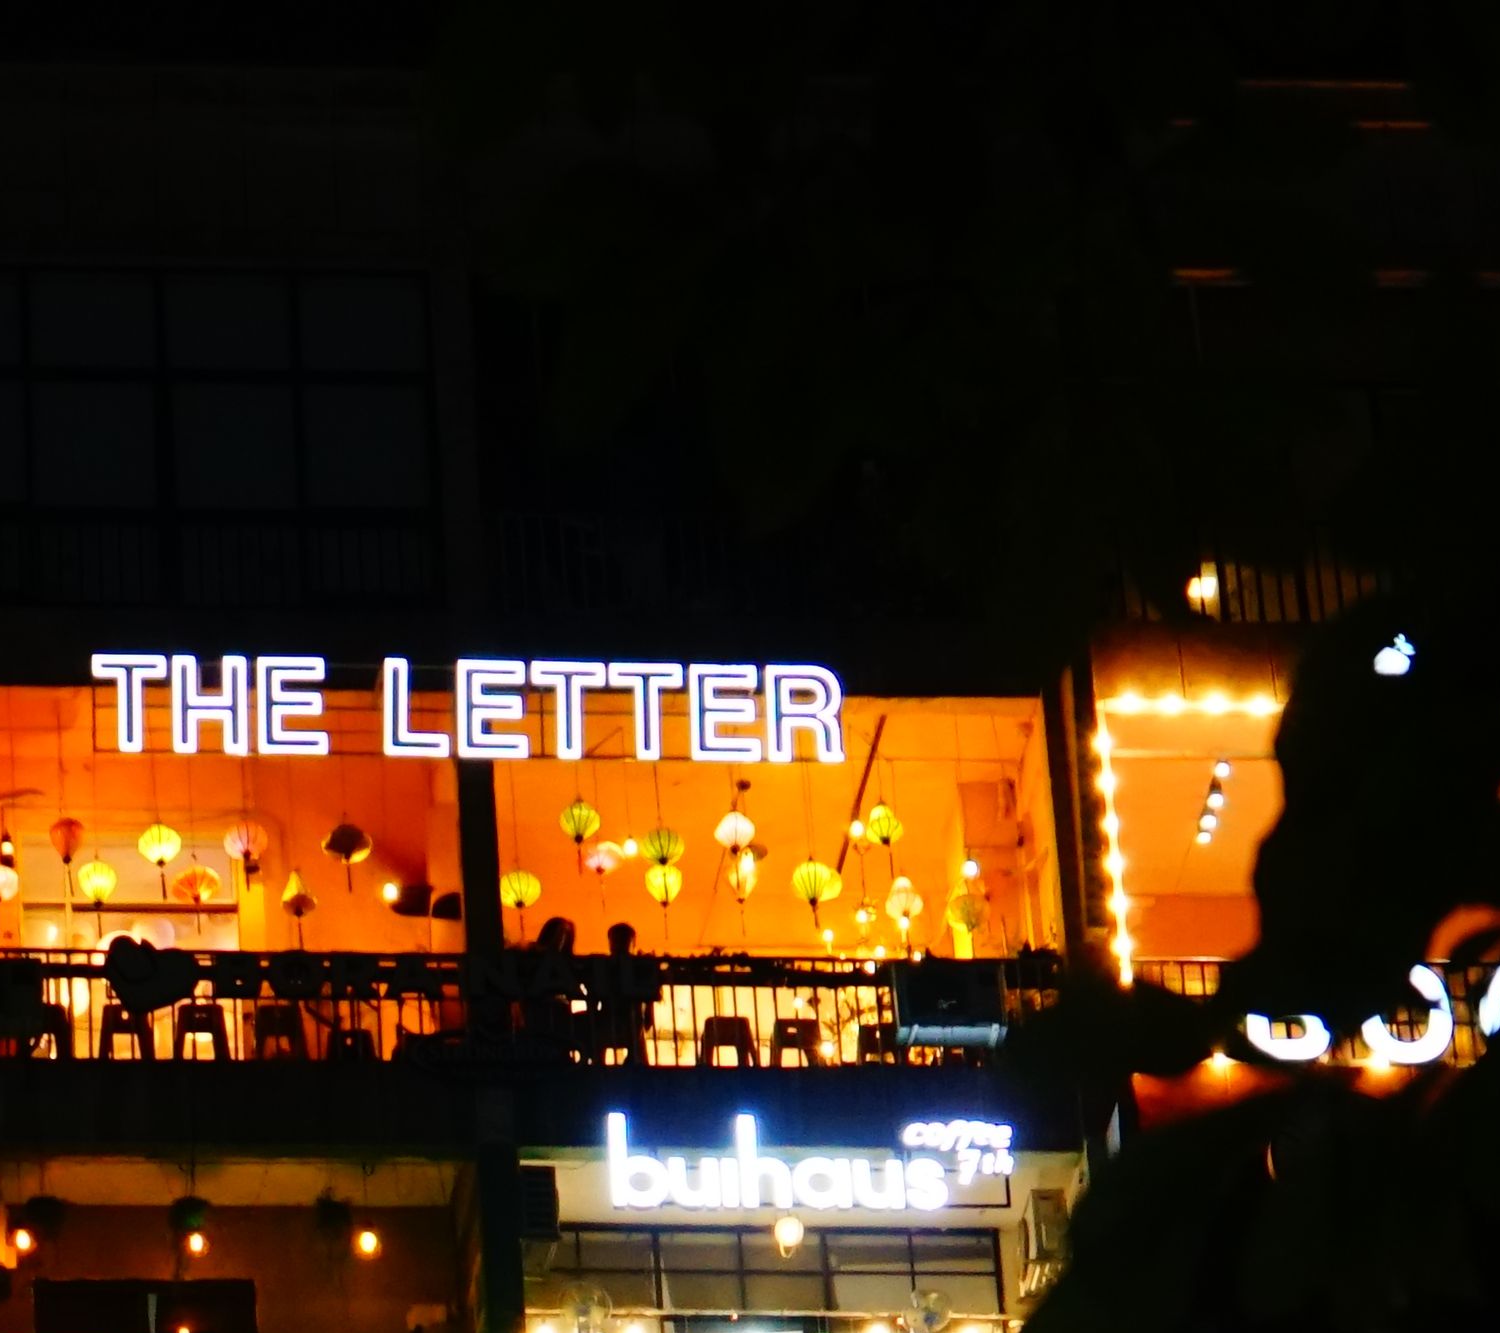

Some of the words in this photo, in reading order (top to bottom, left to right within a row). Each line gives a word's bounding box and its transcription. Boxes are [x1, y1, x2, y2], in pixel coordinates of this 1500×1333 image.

[91, 653, 329, 756] THE
[383, 657, 845, 763] LETTER
[605, 1110, 950, 1211] buihaus
